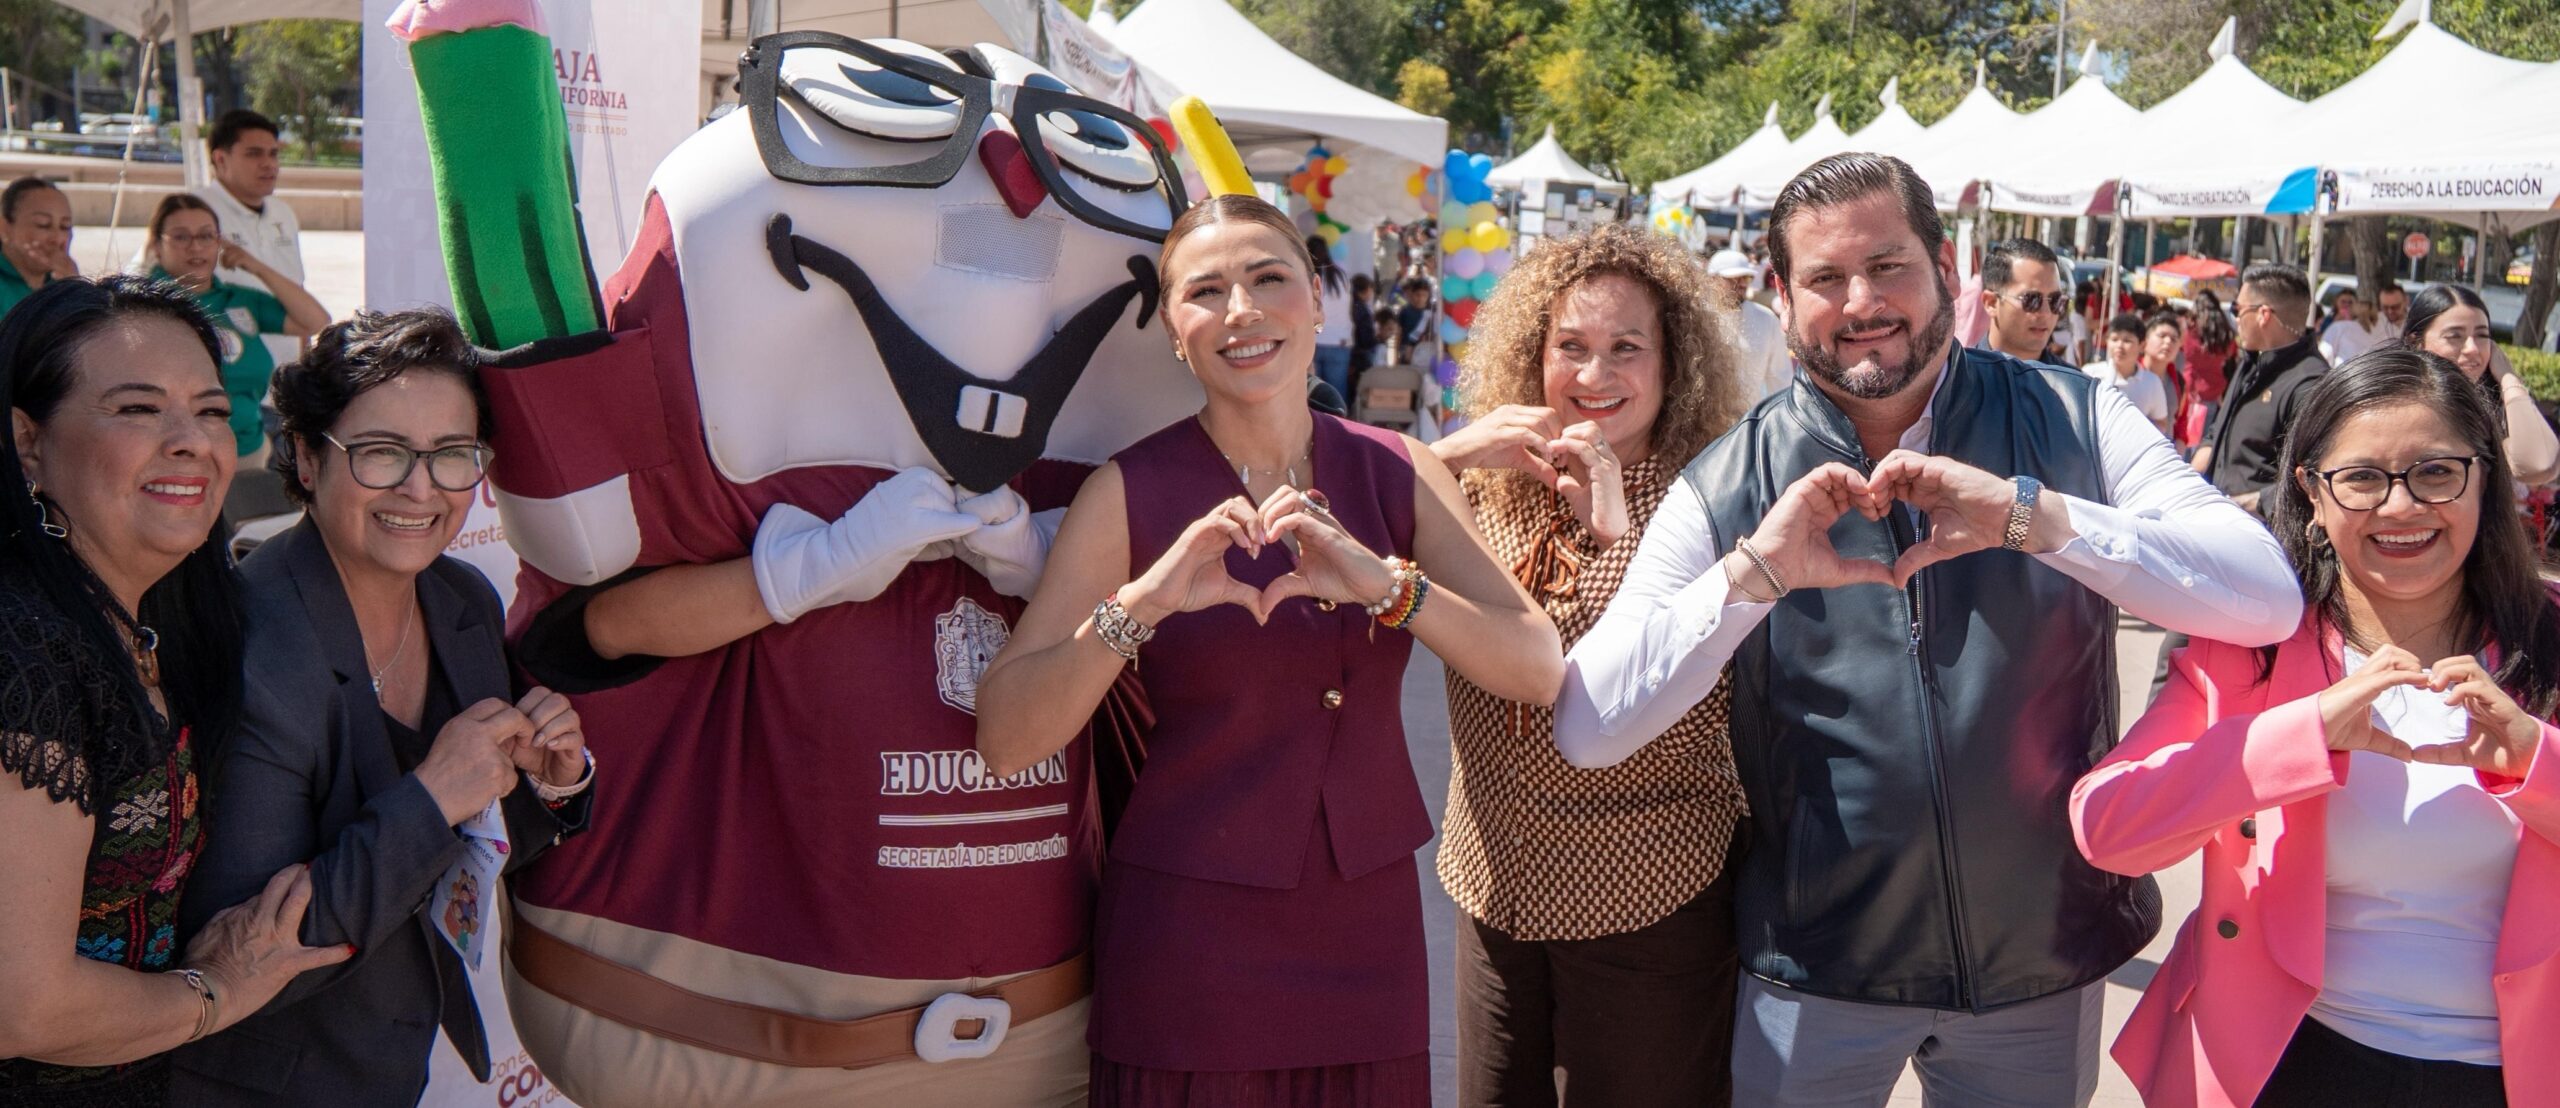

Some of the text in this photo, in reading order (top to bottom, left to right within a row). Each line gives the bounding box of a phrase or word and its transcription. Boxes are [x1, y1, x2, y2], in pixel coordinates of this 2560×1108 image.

[553, 48, 602, 84] AJA
[560, 86, 628, 110] IFORNIA
[2192, 187, 2251, 205] HIDRATACIÓN
[2371, 173, 2542, 198] DERECHO A LA EDUCACIÓN
[879, 834, 1068, 867] SECRETARÍA DE EDUCACIÓN
